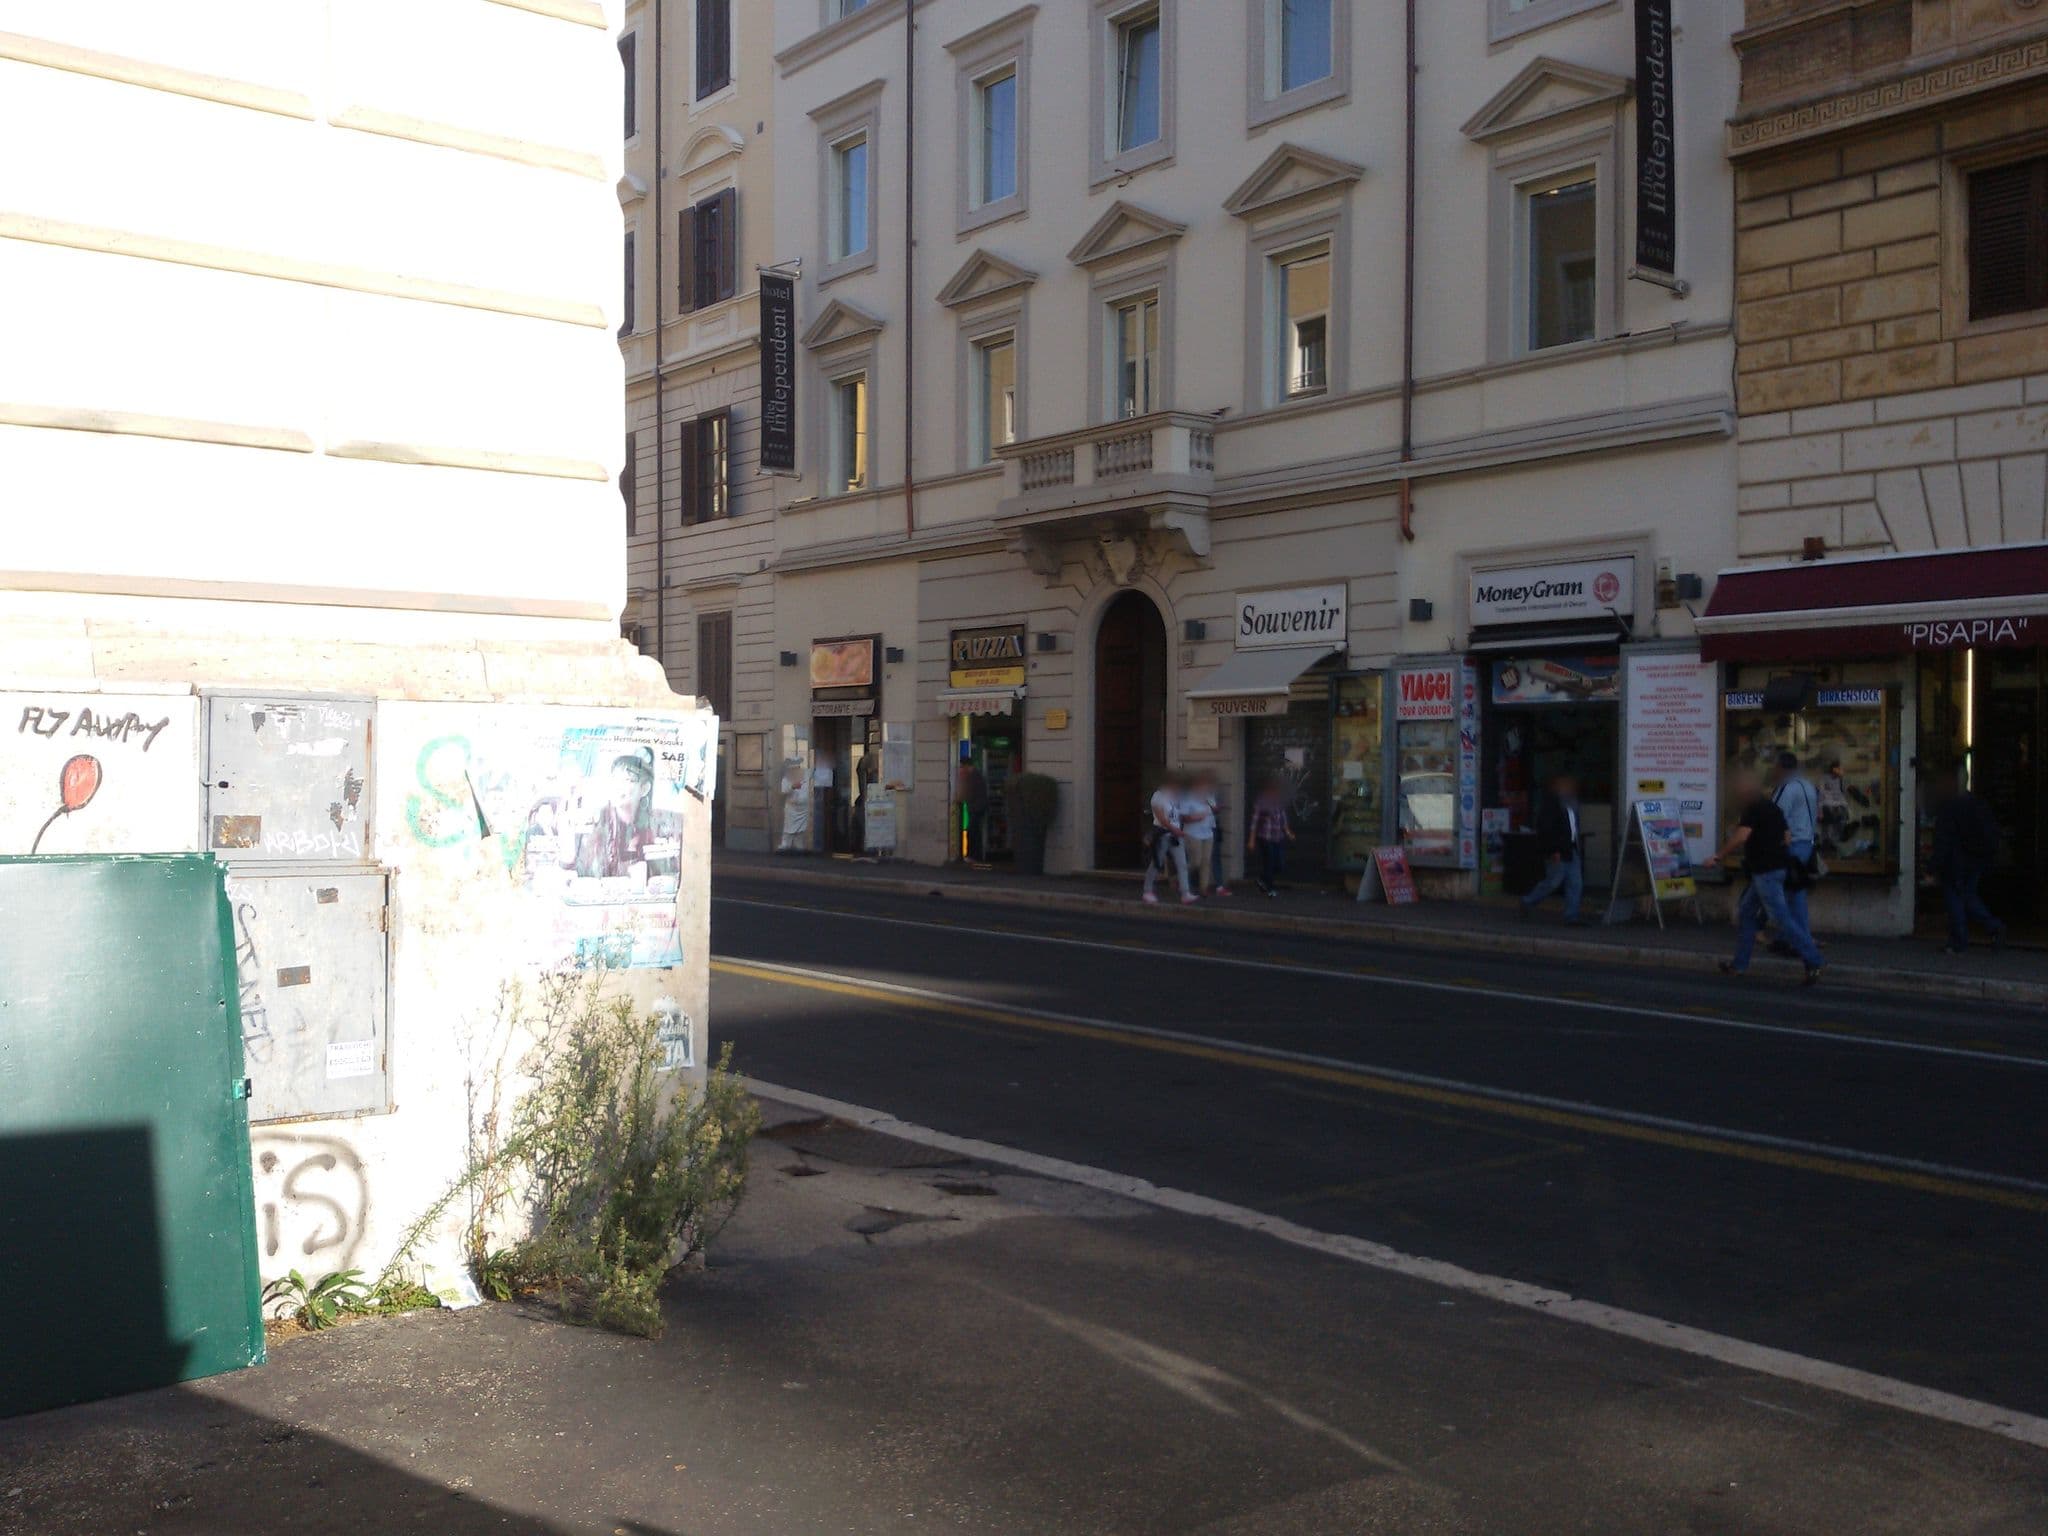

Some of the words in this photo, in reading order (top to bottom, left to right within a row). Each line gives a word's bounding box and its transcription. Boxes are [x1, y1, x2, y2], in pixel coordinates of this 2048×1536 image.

[762, 287, 790, 300] hotel
[769, 306, 791, 432] Independent
[1476, 580, 1583, 604] MoneyGram
[1240, 599, 1340, 636] Souvenir
[1904, 617, 2029, 645] "PISAPIA"
[953, 635, 1023, 661] PIZZA
[1400, 672, 1451, 702] VIAGGI
[1819, 690, 1880, 703] BIRKENSTOCK
[811, 703, 850, 716] RISTORANTE
[949, 700, 1000, 711] PIZZERIA
[1210, 698, 1268, 714] SOUVENIR
[1727, 693, 1764, 706] BIRKENS
